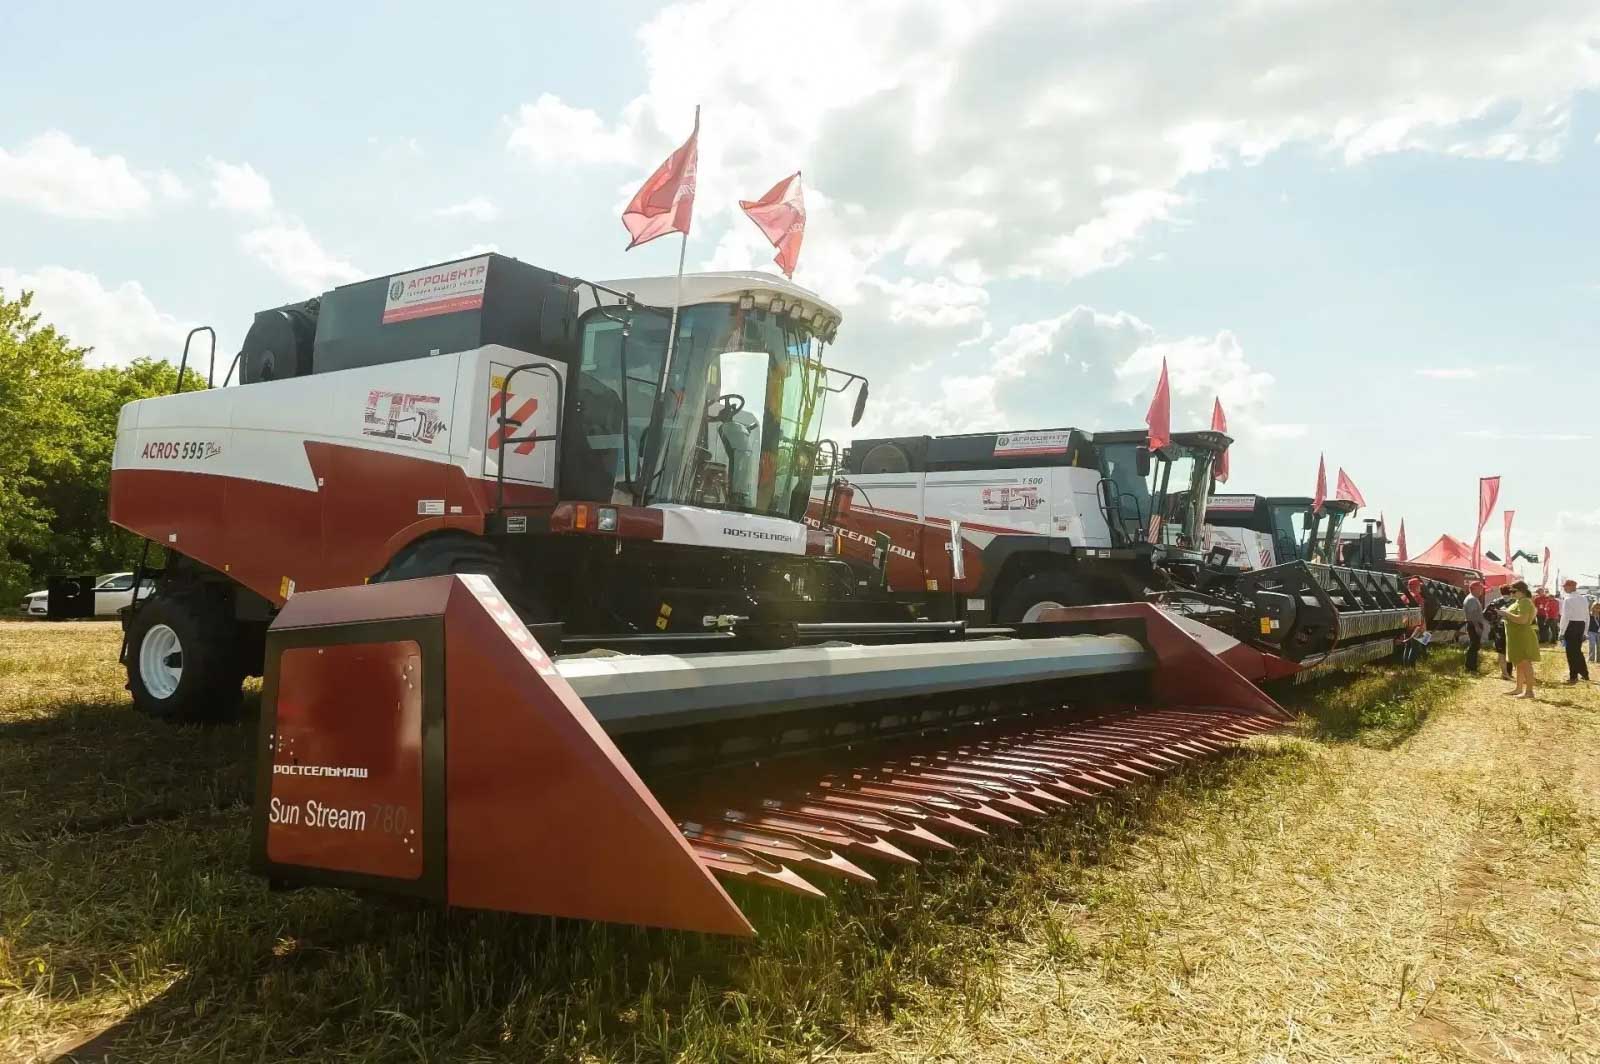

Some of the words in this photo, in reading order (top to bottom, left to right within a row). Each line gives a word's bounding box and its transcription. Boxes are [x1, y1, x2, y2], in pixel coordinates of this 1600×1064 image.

[408, 265, 486, 289] АГРОЦЕНТР
[141, 442, 180, 459] ACROS
[181, 441, 204, 459] 595
[1028, 477, 1044, 485] 500
[723, 527, 792, 542] ROSTSELMASH
[803, 516, 916, 560] РОСТСЕЛЬАШ
[273, 764, 368, 778] РОСТСЕЛЬМАШ
[269, 797, 300, 825] Sun
[304, 799, 366, 831] Stream
[370, 804, 408, 834] 780
